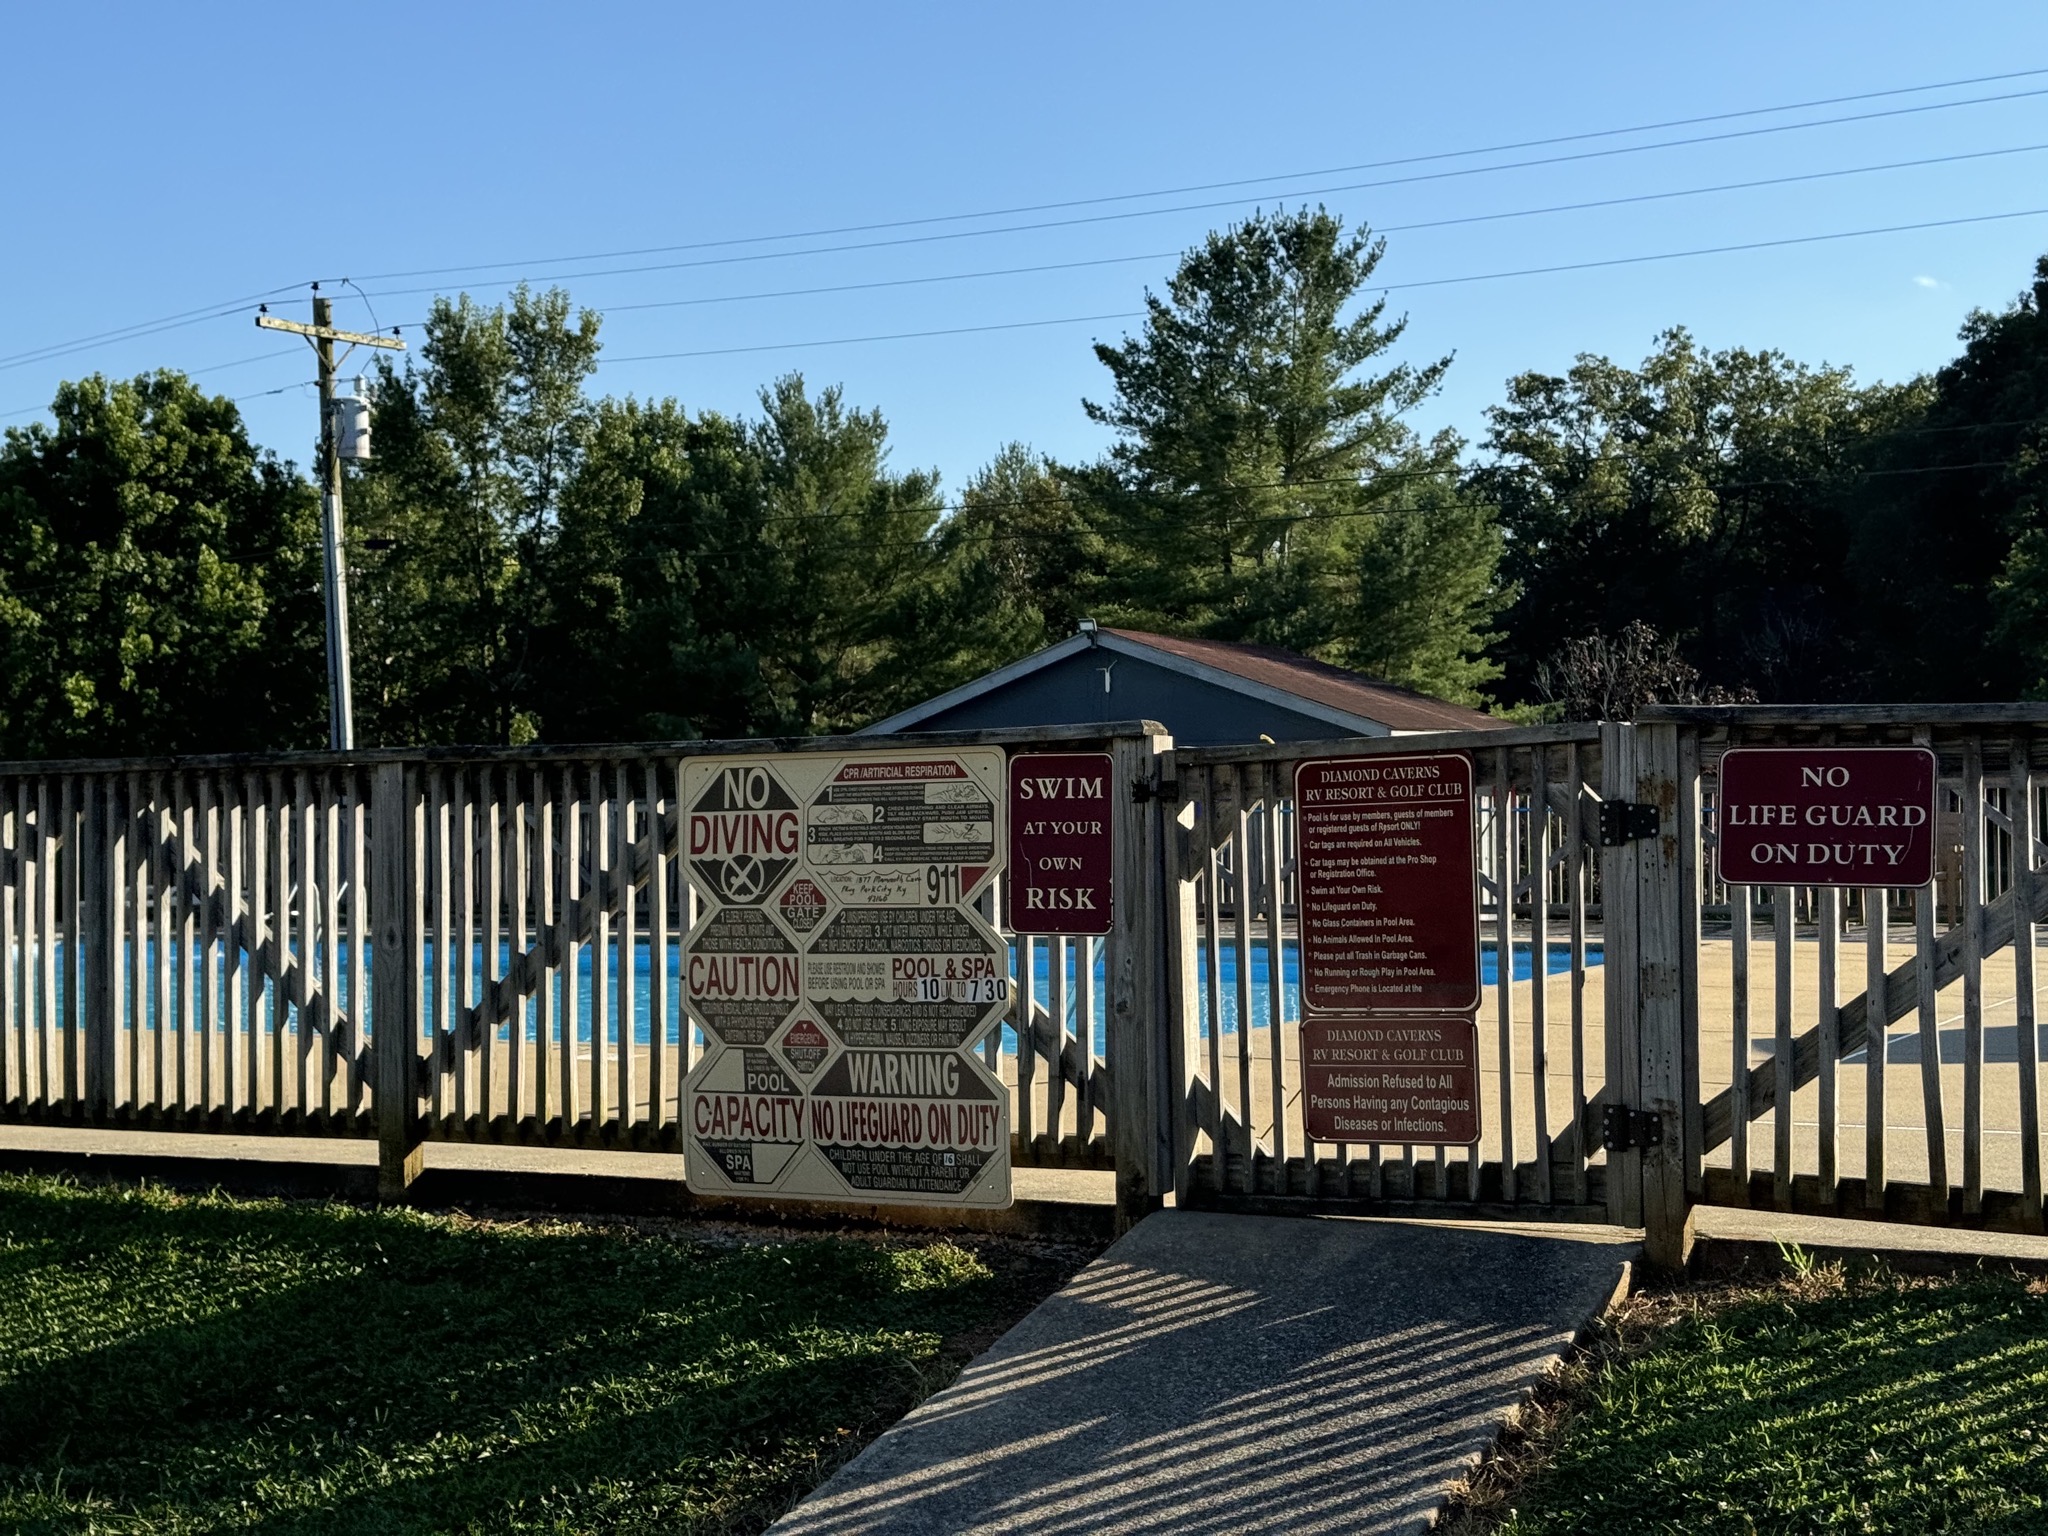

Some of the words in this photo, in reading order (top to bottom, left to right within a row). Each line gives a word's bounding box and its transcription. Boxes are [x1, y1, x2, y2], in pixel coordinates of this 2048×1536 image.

[905, 765, 956, 776] RESPIRATION
[1321, 769, 1379, 782] DIAMOND
[1383, 766, 1439, 780] CAVERNS
[1801, 767, 1849, 787] NO
[724, 767, 769, 809] NO
[1020, 777, 1103, 799] SWIM
[1306, 789, 1322, 801] RV
[1326, 787, 1374, 800] RESORT
[1378, 787, 1386, 798] &
[1390, 785, 1424, 797] GOLF
[1428, 783, 1462, 796] CLUB
[875, 806, 884, 822] 2
[1308, 813, 1322, 822] Pool
[1353, 812, 1360, 822] by
[1362, 811, 1392, 820] members,
[1394, 811, 1415, 820] guests
[1424, 809, 1453, 817] members
[1729, 805, 1797, 825] LIFE
[1805, 805, 1926, 826] GUARD
[690, 812, 798, 854] DIVING
[808, 827, 815, 842] 3
[1023, 822, 1046, 834] AT
[1050, 822, 1102, 834] YOUR
[1317, 825, 1347, 835] registered
[1349, 825, 1369, 834] guests
[1371, 823, 1377, 831] of
[1401, 821, 1420, 830] ONLY!
[1310, 841, 1320, 849] Car
[1322, 841, 1334, 850] tags
[1348, 839, 1373, 849] required
[1394, 837, 1421, 846] Vehicles.
[874, 846, 883, 862] 4
[1310, 858, 1320, 866] Car
[1322, 857, 1335, 868] tags
[1337, 857, 1350, 867] may
[1351, 857, 1359, 865] be
[1360, 856, 1387, 865] obtained
[1389, 856, 1395, 864] at
[1396, 855, 1406, 864] the
[1420, 854, 1436, 865] Shop
[1751, 843, 1799, 864] ON
[1807, 844, 1904, 865] DUTY
[1039, 857, 1082, 870] OWN
[1318, 869, 1355, 880] Registration
[1356, 869, 1376, 877] Office.
[793, 884, 813, 894] KEEP
[927, 865, 960, 905] 911
[1311, 886, 1327, 895] Swim
[1329, 886, 1335, 894] at
[1336, 886, 1350, 894] Your
[1368, 885, 1383, 893] Risk.
[790, 894, 818, 904] POOL
[1026, 888, 1096, 910] RISK
[787, 908, 819, 918] GATE
[1322, 902, 1350, 912] Lifeguard
[1362, 902, 1377, 911] Duty.
[793, 918, 813, 928] CLOSED
[1341, 918, 1374, 927] Containers
[1382, 951, 1407, 961] Garbage
[689, 955, 799, 996] CAUTION
[892, 958, 941, 978] POOL
[945, 958, 957, 978] &
[961, 958, 996, 978] SPA
[1325, 968, 1350, 978] Running
[1360, 968, 1381, 978] Rough
[1382, 968, 1394, 977] Play
[893, 981, 918, 998] HOURS
[921, 978, 939, 1000] 10
[957, 982, 966, 998] TO
[1315, 985, 1349, 995] Emergency
[1379, 984, 1403, 992] Located
[1327, 1030, 1383, 1041] DIAMOND
[1387, 1030, 1441, 1041] CAVERNS
[1313, 1049, 1328, 1060] RV
[1332, 1049, 1378, 1060] RESORT
[1382, 1050, 1390, 1060] &
[1394, 1049, 1428, 1060] GOLF
[1431, 1049, 1463, 1060] CLUB
[847, 1053, 959, 1095] WARNING
[1328, 1073, 1379, 1088] Admission
[1383, 1074, 1423, 1088] Refused
[1426, 1075, 1435, 1088] to
[1439, 1074, 1452, 1088] All
[748, 1073, 789, 1092] POOL
[1311, 1095, 1350, 1109] Persons
[1353, 1096, 1387, 1113] Having
[1390, 1099, 1408, 1113] any
[1411, 1096, 1469, 1114] Contagious
[695, 1095, 805, 1138] CAPACITY
[812, 1100, 834, 1140] NO
[839, 1101, 922, 1143] LIFEGUARD
[928, 1103, 950, 1144] ON
[958, 1104, 999, 1145] DUTY
[1334, 1116, 1378, 1131] Diseases
[1381, 1119, 1391, 1131] or
[1394, 1117, 1446, 1132] Infections.
[726, 1155, 751, 1170] SPA
[829, 1149, 867, 1161] CHILDREN
[869, 1151, 895, 1162] UNDER
[897, 1152, 912, 1163] THE
[915, 1152, 930, 1164] AGE
[932, 1153, 942, 1164] OF
[956, 1154, 982, 1166] SHALL
